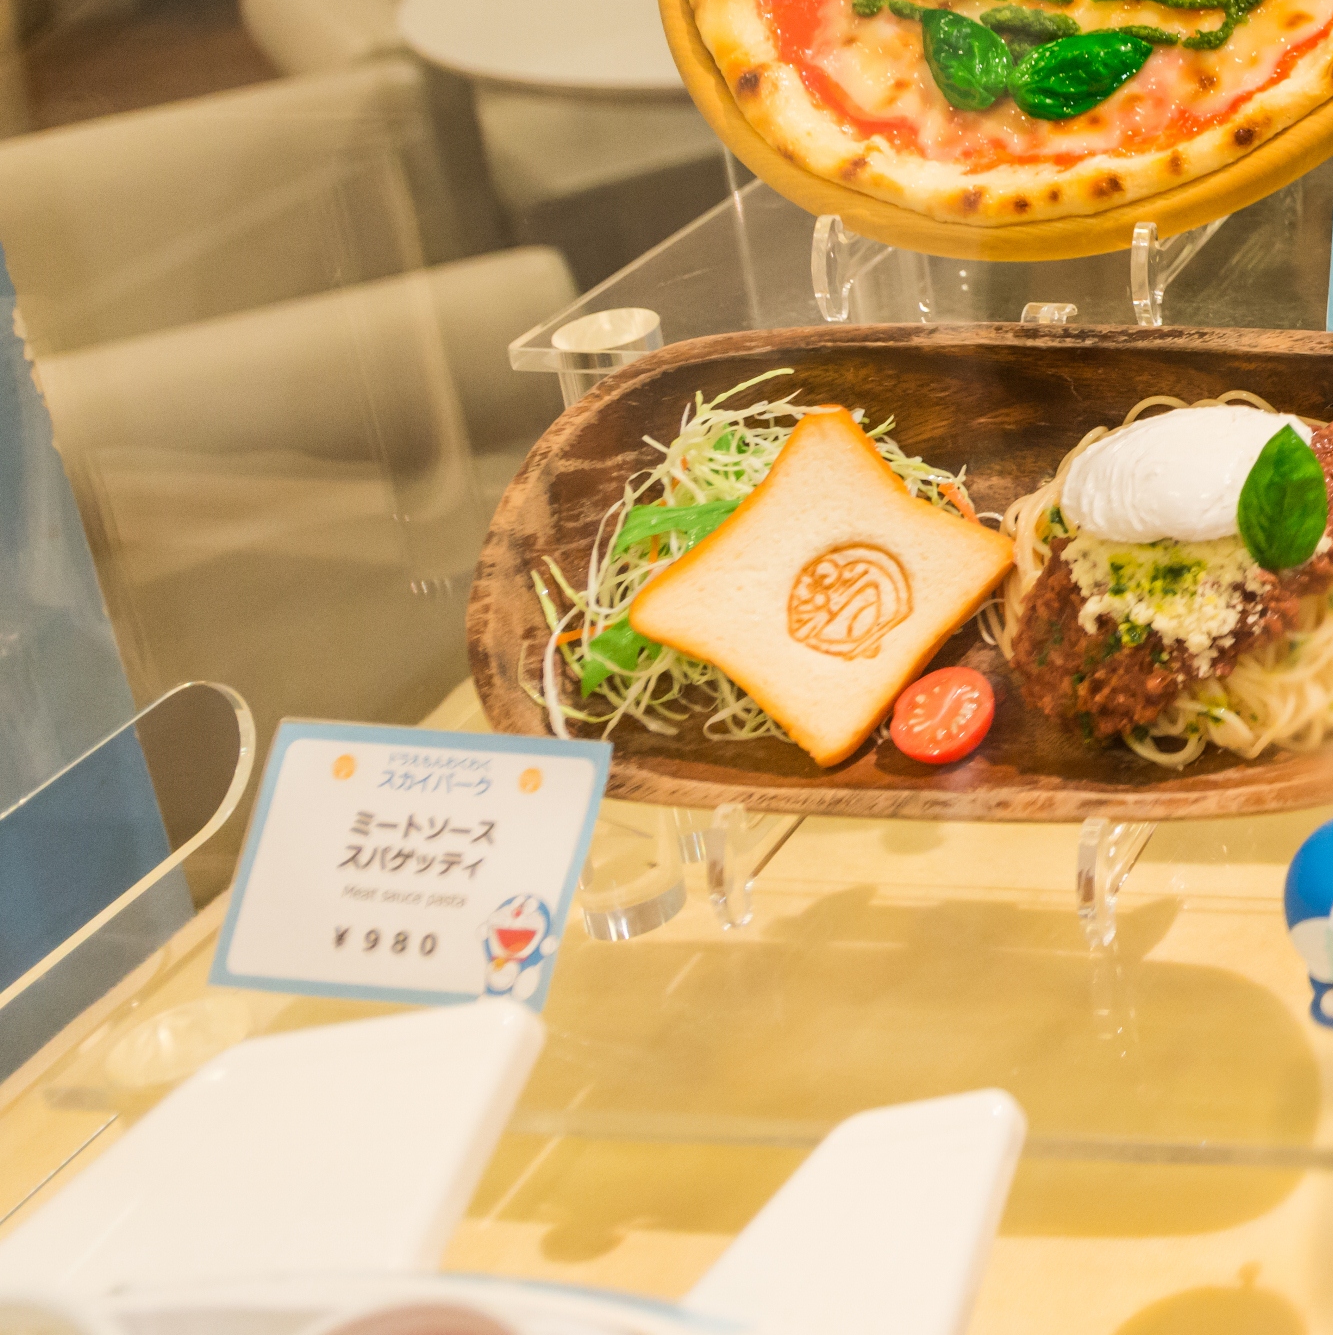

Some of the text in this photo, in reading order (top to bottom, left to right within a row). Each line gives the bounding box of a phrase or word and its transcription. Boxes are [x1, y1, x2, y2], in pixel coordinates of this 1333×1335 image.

[377, 769, 493, 797] スカイパーク
[349, 810, 497, 846] ミートソース
[336, 844, 486, 880] スパゲッティ
